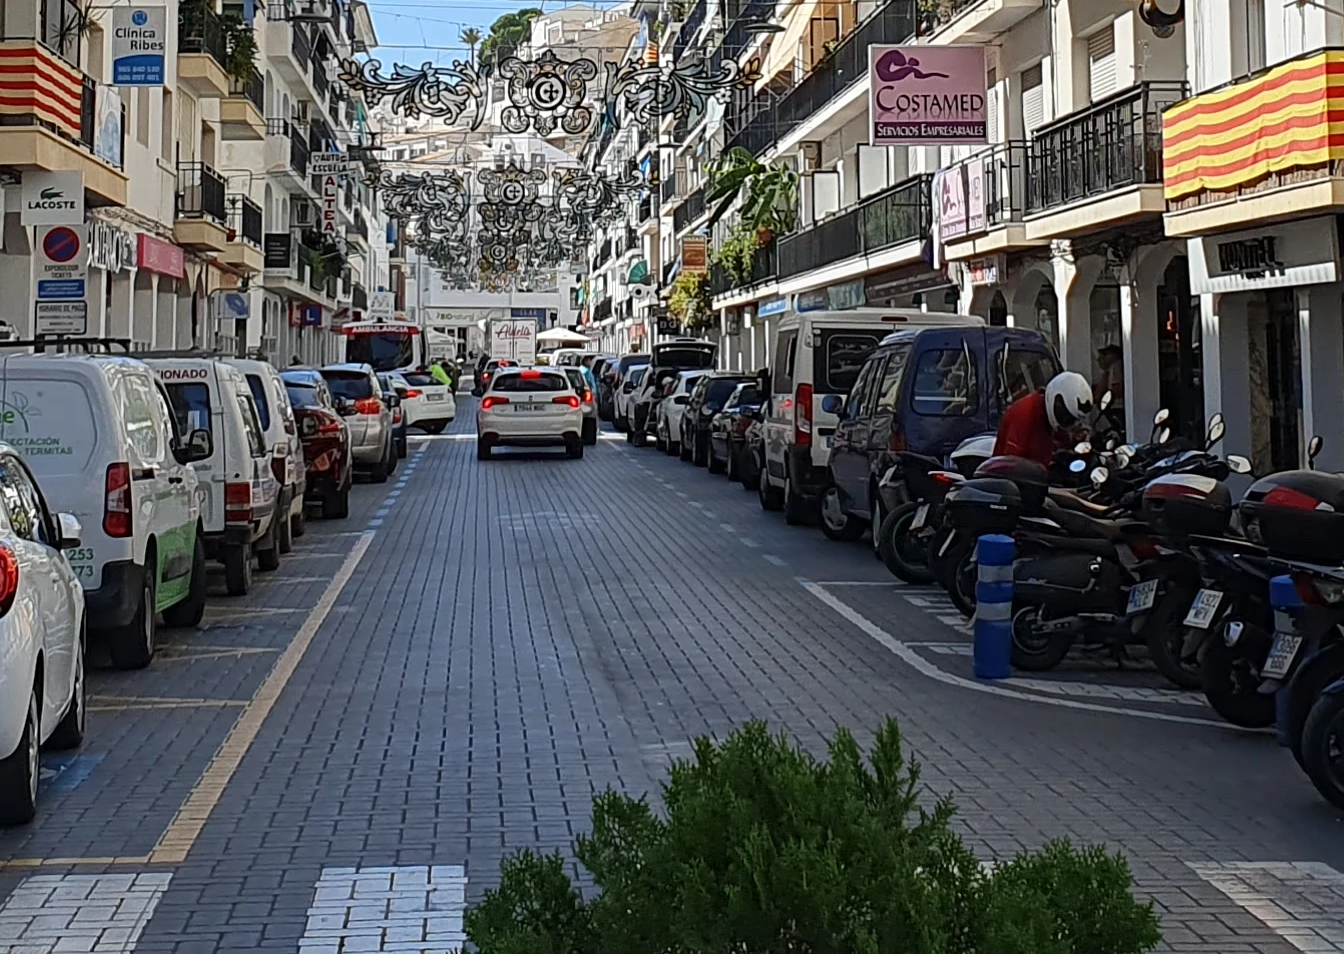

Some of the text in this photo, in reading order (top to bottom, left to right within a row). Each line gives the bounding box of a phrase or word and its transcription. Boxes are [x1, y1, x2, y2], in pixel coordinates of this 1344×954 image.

[115, 27, 156, 38] Clínica
[130, 39, 164, 50] Ribes
[876, 85, 984, 113] COSTAMED
[878, 123, 984, 136] SERVICIOS EMPRESARIALES
[312, 164, 348, 173] ESCUELA
[28, 201, 76, 210] LACOSTE
[324, 176, 336, 233] ALTEA
[157, 369, 208, 379] IONADO
[24, 447, 73, 456] TERMITAS
[68, 548, 94, 560] 253
